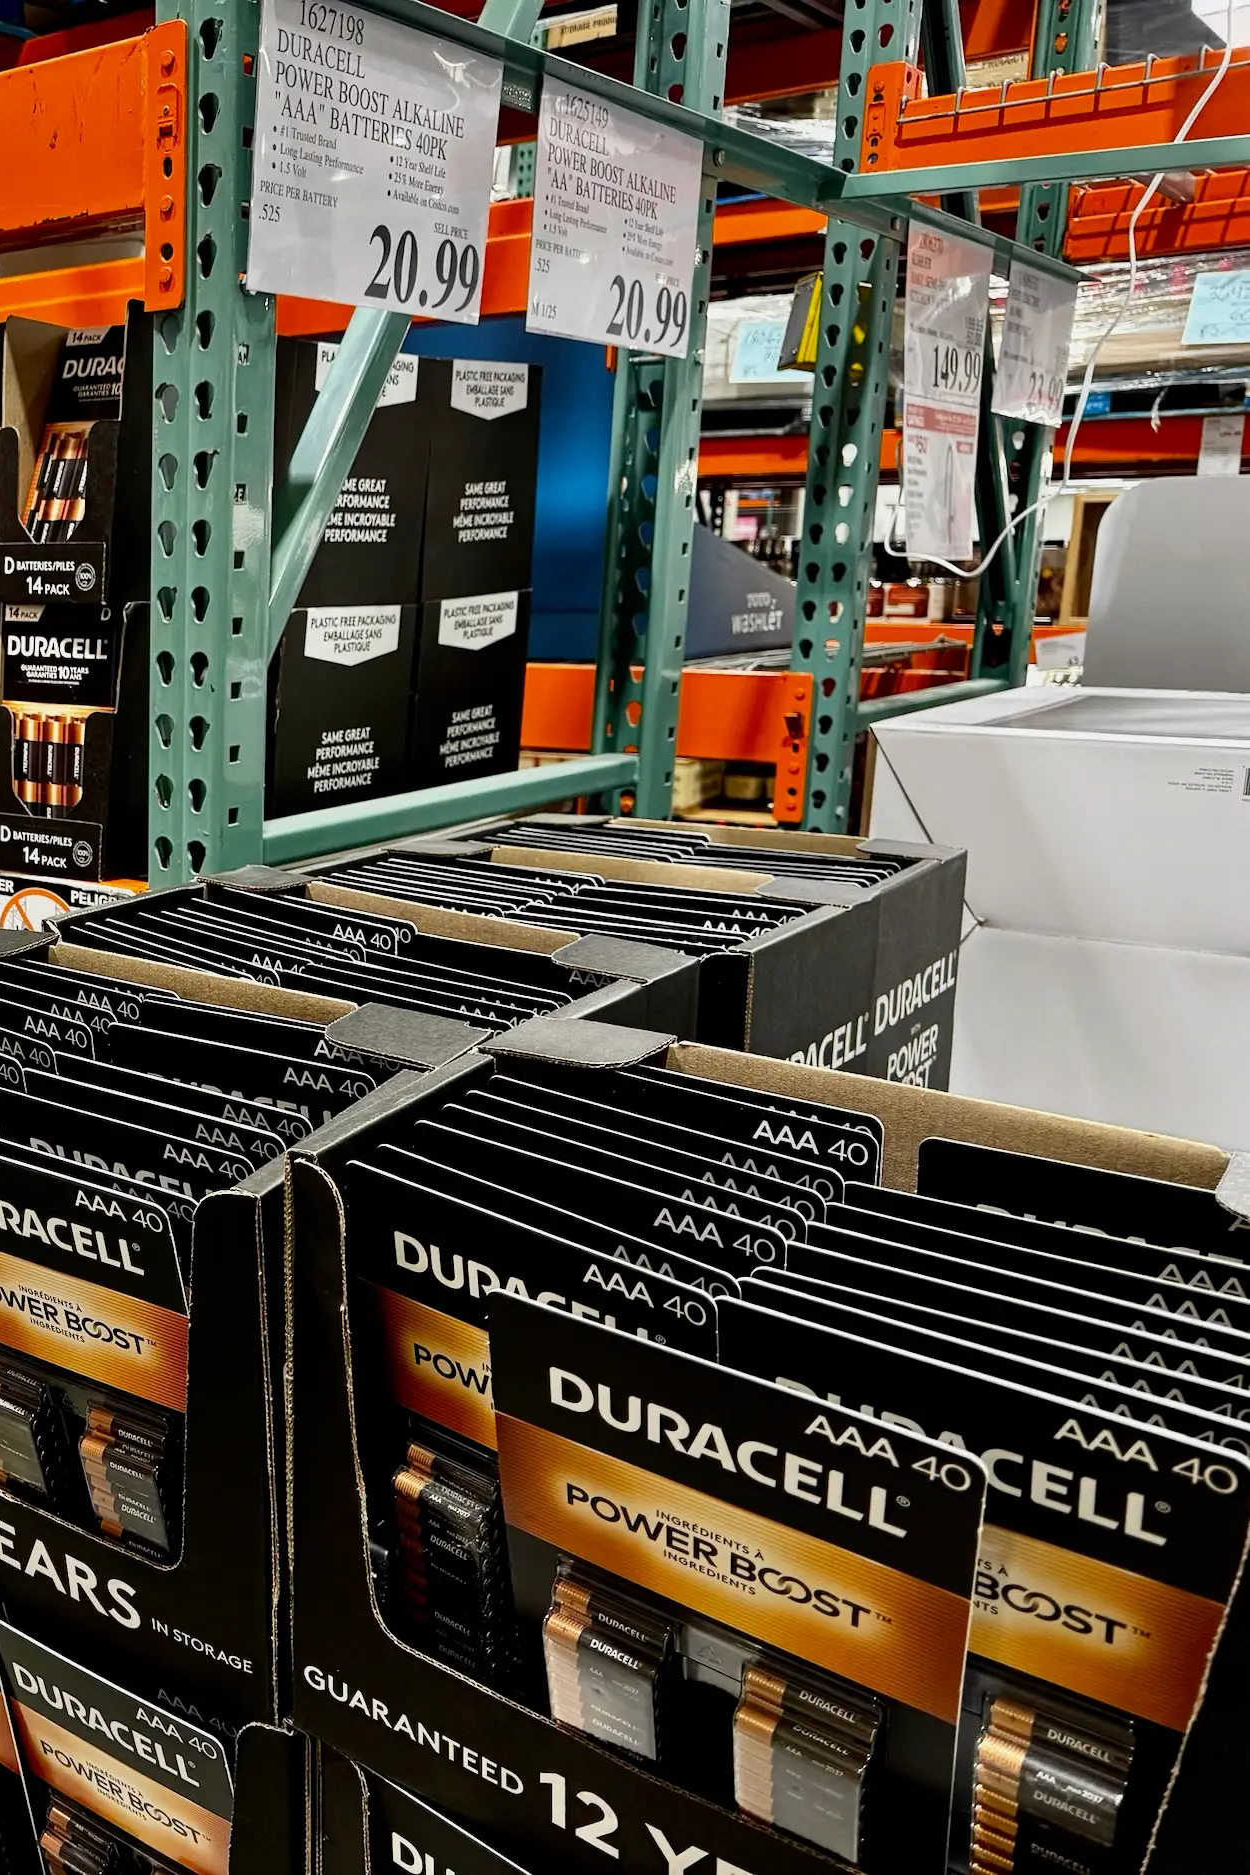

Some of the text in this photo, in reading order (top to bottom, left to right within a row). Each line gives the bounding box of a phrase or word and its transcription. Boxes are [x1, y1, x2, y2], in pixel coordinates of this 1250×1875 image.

[300, 1, 365, 45] 1627198
[277, 28, 365, 79] DURACELL
[275, 60, 465, 139] POWER BOOST ALKALINE
[275, 91, 448, 161] "AAA" BATTERIES 40PK
[291, 128, 317, 146] Trusted
[318, 134, 337, 150] Brand
[550, 117, 609, 157] DURACELL
[279, 161, 307, 179] 1.5 Volt
[280, 143, 364, 175] Long Lasting Performance
[395, 155, 446, 179] 12 Year Shelf Life
[547, 142, 677, 204] POWER BOOST ALKALINE
[260, 180, 338, 209] PRICE PER BATTERY
[392, 189, 419, 204] Available
[428, 198, 460, 215] Costco.com
[394, 171, 444, 196] 25% More Energy
[576, 176, 634, 213] BATTERIES
[635, 196, 658, 220] 40PK
[258, 203, 281, 223] .525
[433, 222, 469, 240] SELL PRICE
[364, 224, 480, 313] 20.99
[606, 274, 687, 348] 20.99
[933, 344, 981, 394] 149.99
[4, 556, 76, 575] D BATTERIES/PILES
[26, 576, 70, 596] 14 PACK
[8, 606, 39, 620] 14 PACK
[310, 614, 396, 629] PLASTIC FREE PACKAGING
[7, 635, 108, 661] DURACELL
[323, 627, 382, 642] EMBALLAGE SANS
[334, 640, 371, 654] PLASTIQUE
[58, 666, 70, 680] 10
[70, 666, 89, 675] YEARS
[315, 741, 374, 761] PERFORMANCE
[321, 726, 371, 746] SAME GREAT
[307, 757, 380, 780] MÊME INCROYABLE
[313, 772, 372, 794] PERFORMANCE
[0, 825, 73, 848] D BATTERIES/PILES
[22, 846, 67, 869] 14 PACK
[874, 950, 956, 1037] DURACELL
[887, 1023, 939, 1080] POWER
[283, 1067, 334, 1094] AAA
[339, 1078, 369, 1101] 40
[752, 1120, 869, 1167] AAA 40
[74, 1190, 164, 1234] AAA 40
[18, 1284, 73, 1309] INGRÉDIENTS
[582, 1264, 707, 1327] AAA 40
[29, 1317, 86, 1344] INGREDIENTS
[64, 1310, 146, 1356] BOOST
[549, 1366, 908, 1539] DURACELL
[804, 1414, 900, 1468] AAA
[911, 1455, 972, 1493] 40
[1054, 1418, 1239, 1496] AAA 40
[655, 1508, 765, 1562] INGRÉDIENTS À
[565, 1482, 871, 1628] POWER BOOST
[662, 1549, 757, 1596] INGREDIENTS
[973, 1573, 1128, 1645] BOOST
[151, 1617, 169, 1637] IN
[173, 1629, 253, 1675] STORAGE
[589, 1637, 641, 1671] DURACELL
[12, 1660, 200, 1788] DURACELL
[135, 1706, 218, 1761] AAA 40
[303, 1665, 524, 1795] GUARANTEED
[539, 1772, 620, 1860] 12
[1047, 1728, 1111, 1763] DURACELL
[41, 1739, 204, 1845] POWER BOOST
